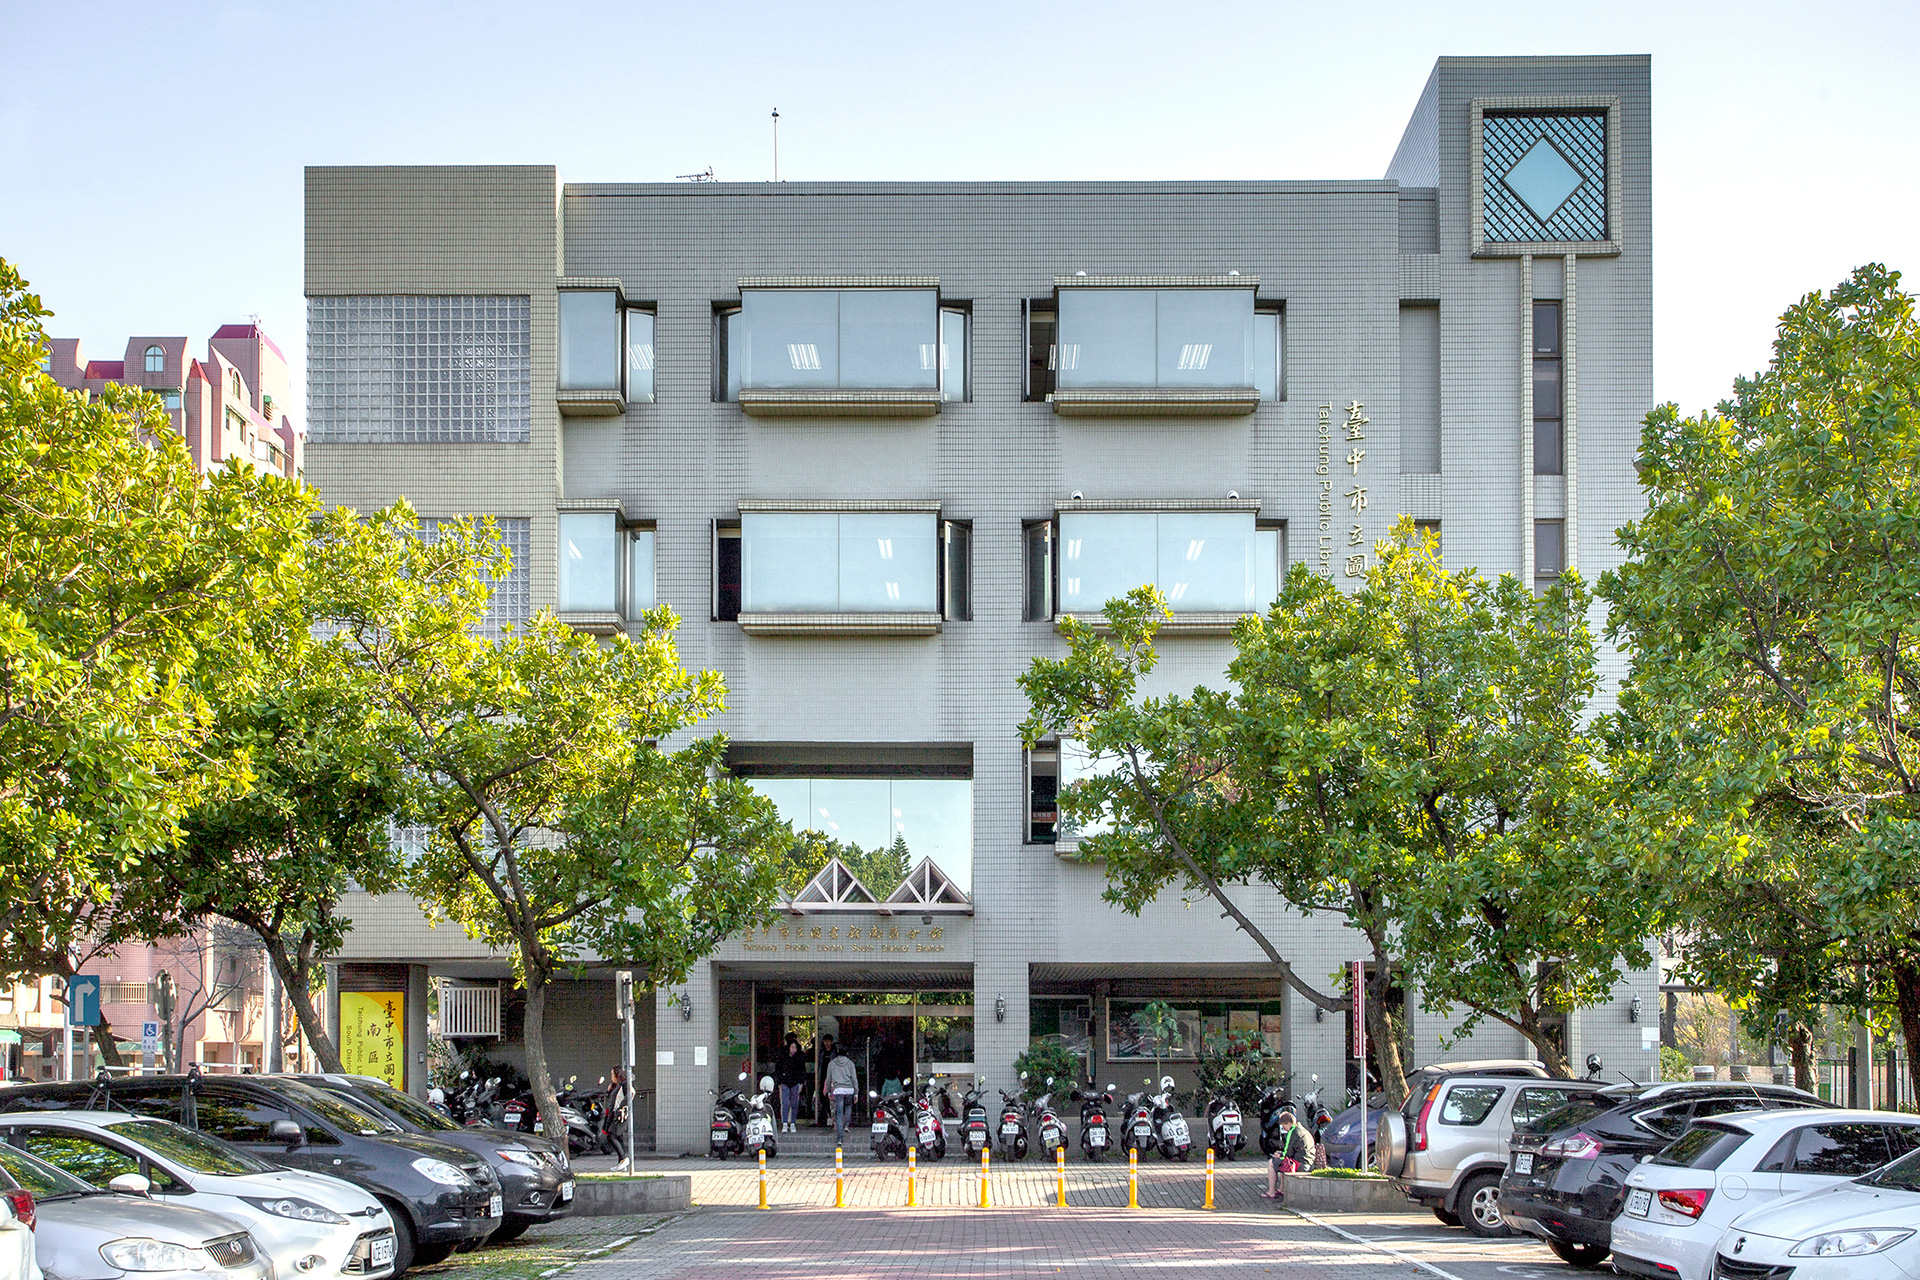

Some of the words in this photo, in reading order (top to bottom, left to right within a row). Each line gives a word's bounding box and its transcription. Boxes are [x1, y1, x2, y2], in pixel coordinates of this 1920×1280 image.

[1316, 400, 1333, 476] Taichung
[1319, 480, 1333, 532] Public
[1341, 400, 1370, 603] 臺中市立圖
[1319, 535, 1333, 581] Libra
[742, 943, 778, 952] Taichung
[784, 943, 810, 952] Public
[816, 943, 845, 953] Library
[851, 943, 875, 952] South
[881, 943, 910, 953] District
[916, 943, 945, 952] Branch
[356, 1006, 364, 1038] Taichung
[356, 1041, 364, 1063] Public
